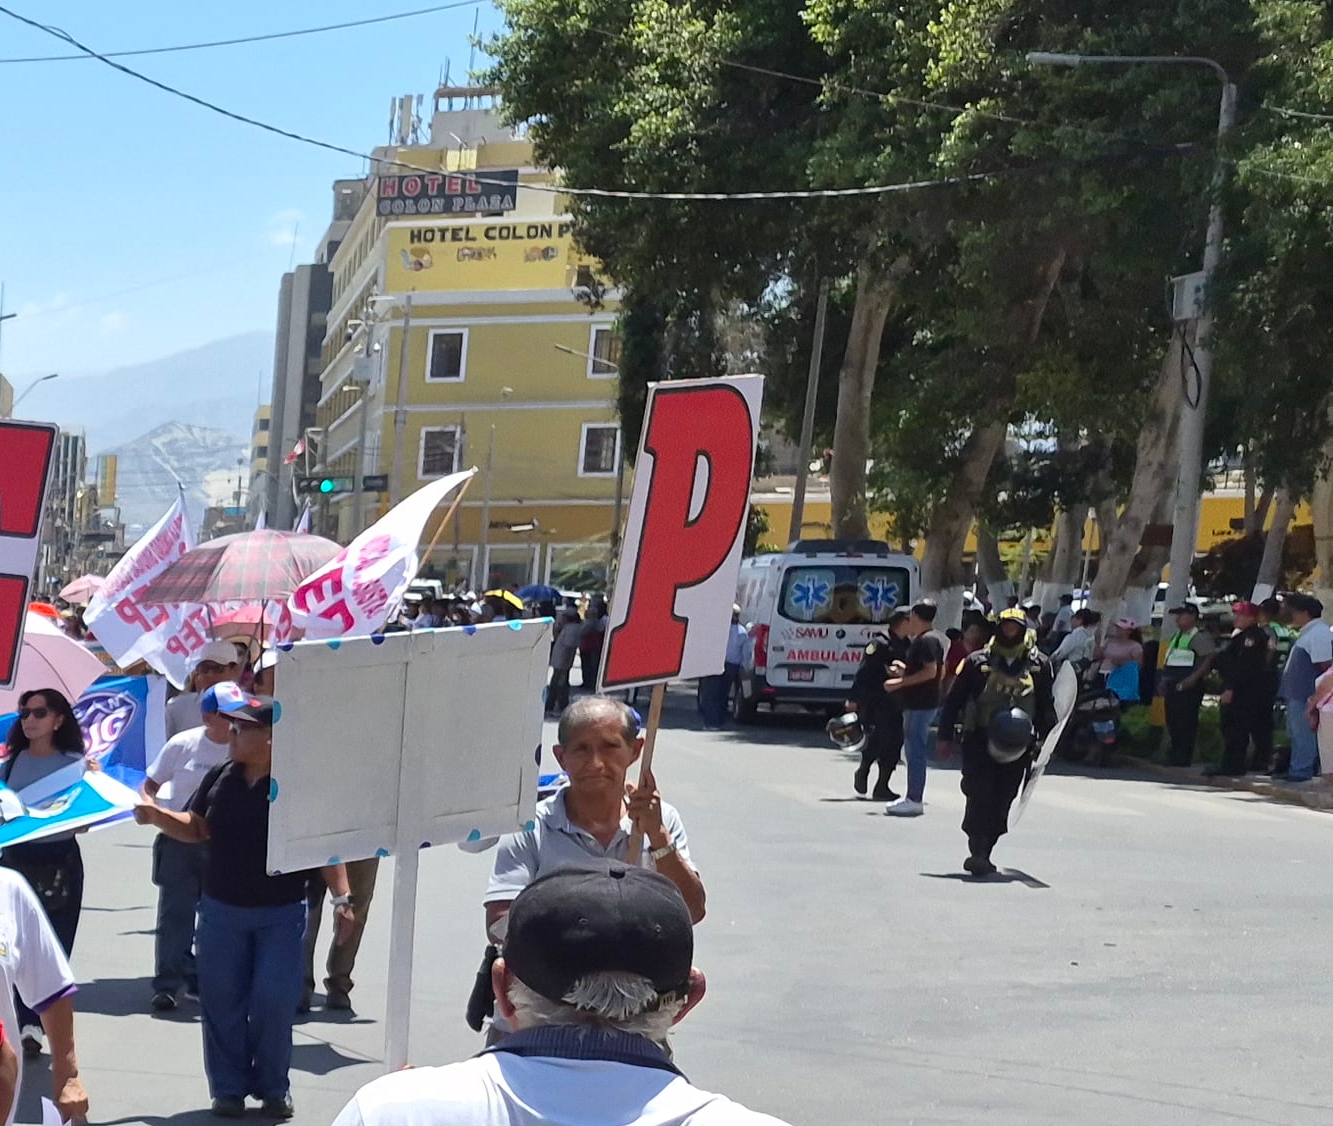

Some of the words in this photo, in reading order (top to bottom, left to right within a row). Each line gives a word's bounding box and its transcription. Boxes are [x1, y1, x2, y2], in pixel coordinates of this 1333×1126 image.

[381, 175, 482, 197] HOTEL
[378, 198, 445, 215] COLON
[410, 226, 477, 245] HOTEL
[484, 223, 553, 242] COLON
[602, 383, 753, 687] P
[795, 626, 829, 640] SAMU
